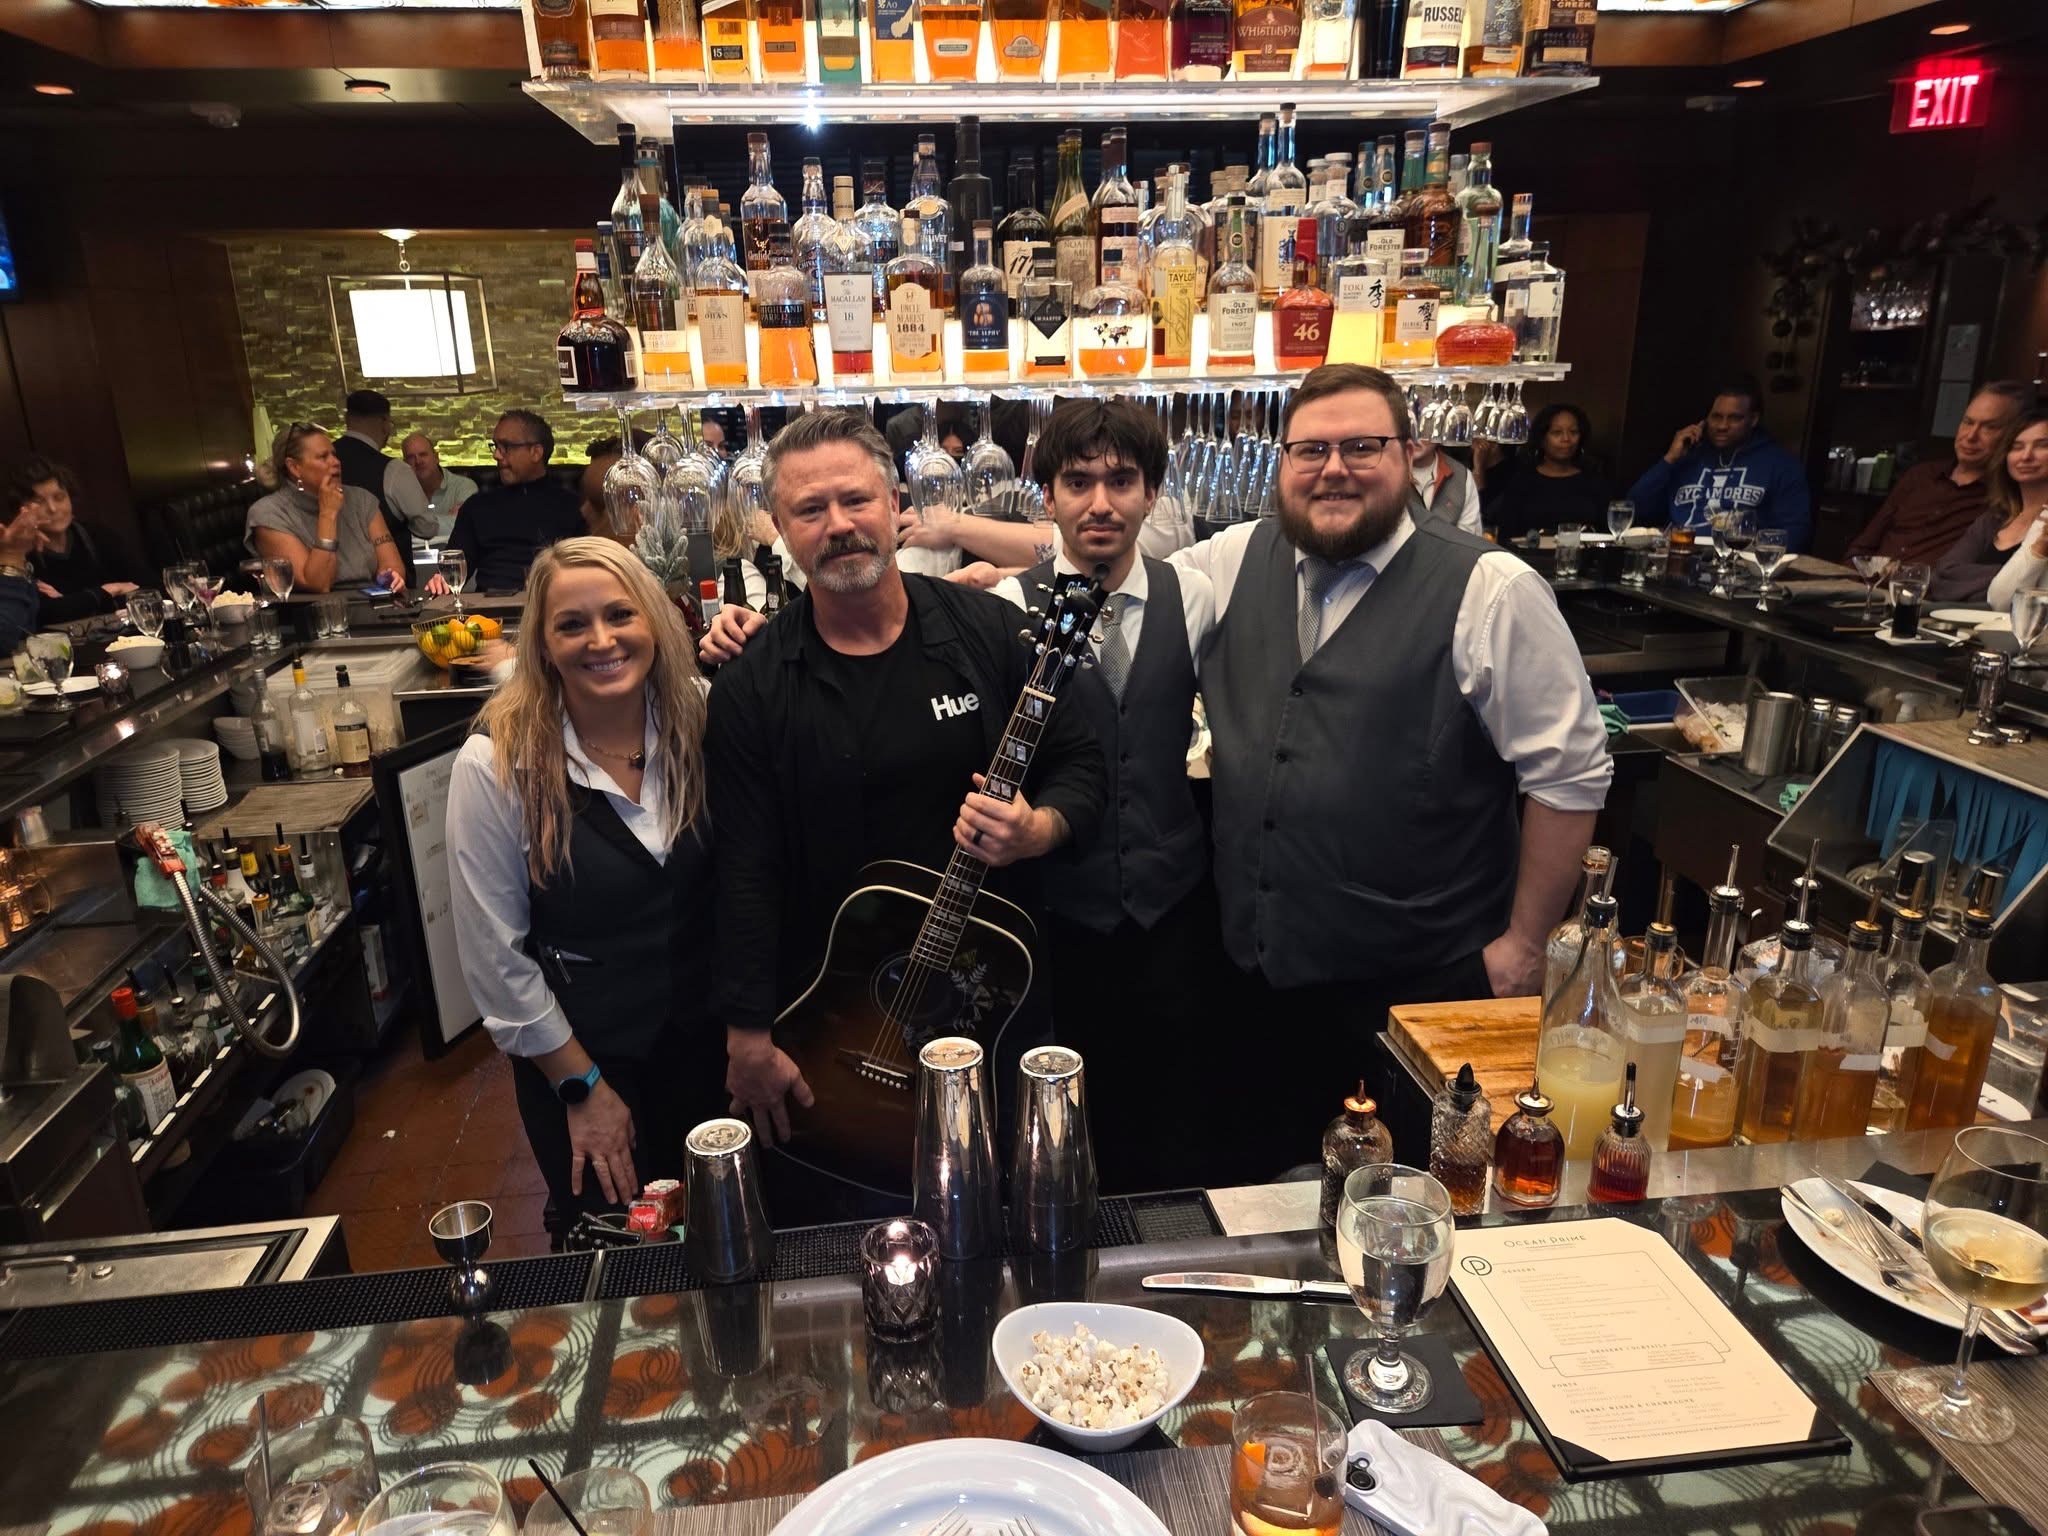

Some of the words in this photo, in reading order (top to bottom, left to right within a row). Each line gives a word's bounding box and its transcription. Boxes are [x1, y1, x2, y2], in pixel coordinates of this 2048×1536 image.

[713, 47, 723, 58] 15
[1264, 43, 1273, 54] 12
[1908, 75, 1980, 128] EXIT
[844, 312, 854, 321] 18
[1222, 307, 1254, 315] FORESTER
[896, 323, 925, 333] 1884
[1294, 322, 1320, 341] 46
[930, 692, 980, 721] Hue
[1503, 1238, 1546, 1248] OCEAN
[1549, 1235, 1587, 1244] PRIME
